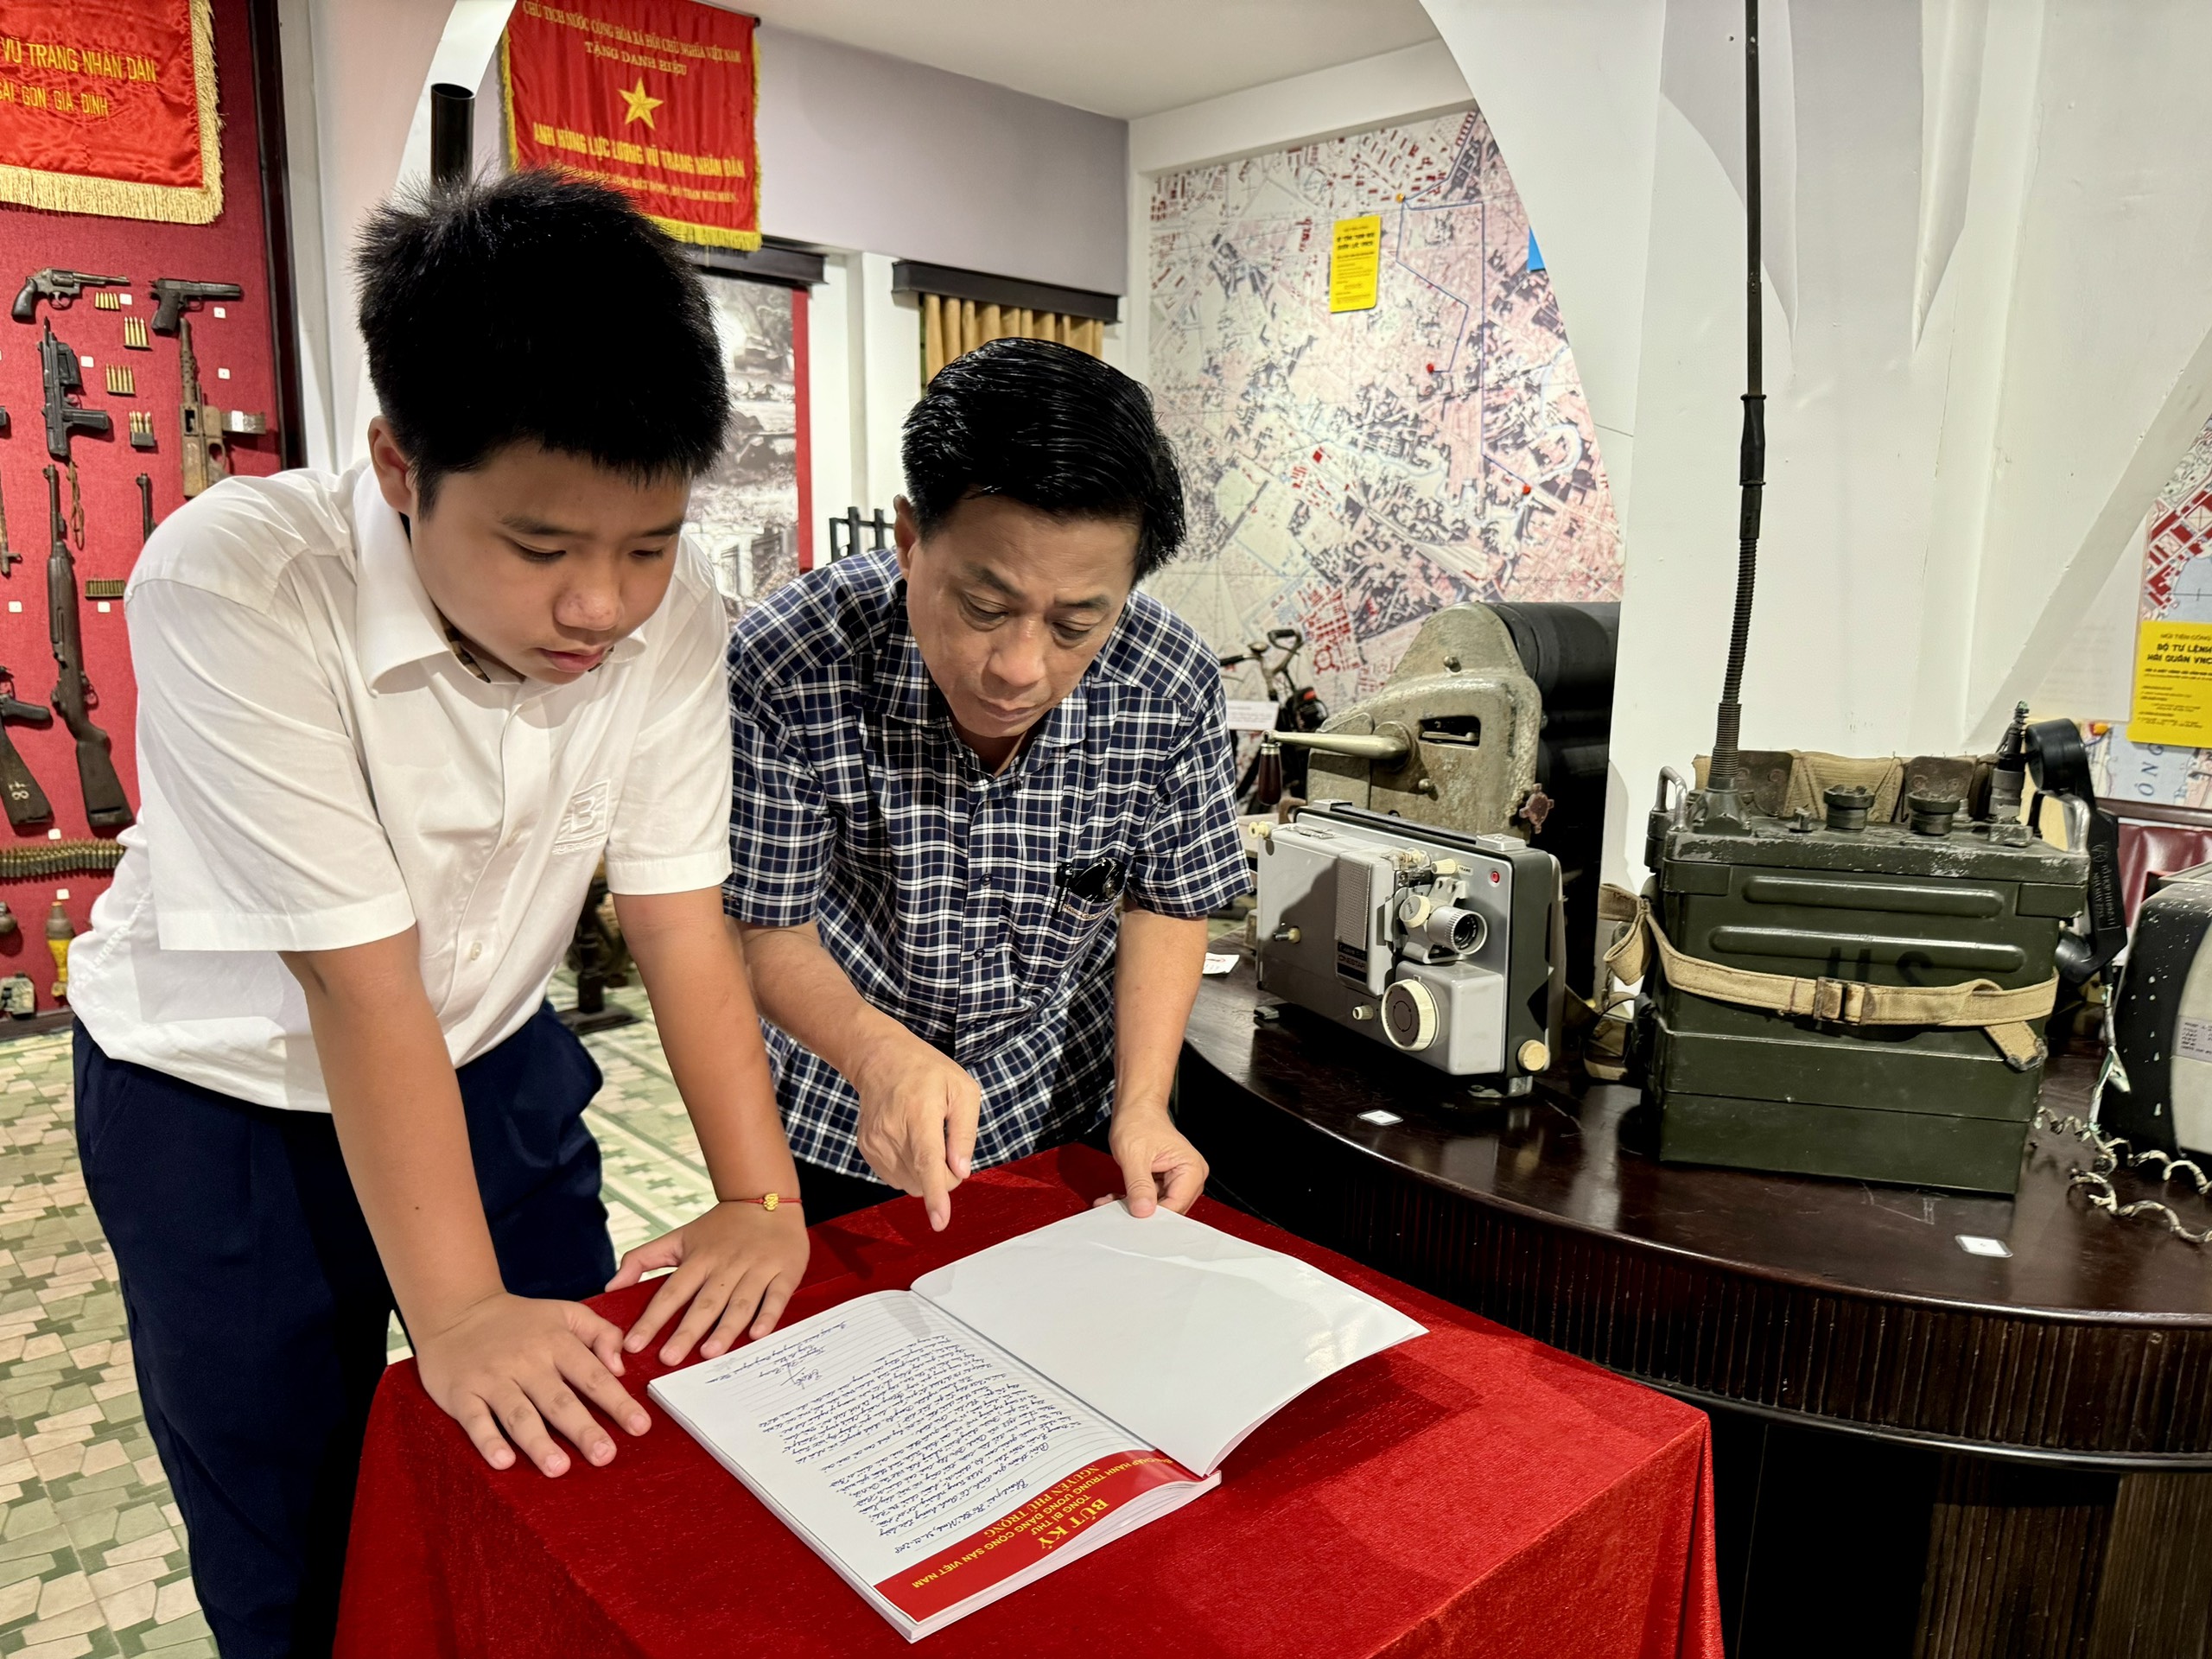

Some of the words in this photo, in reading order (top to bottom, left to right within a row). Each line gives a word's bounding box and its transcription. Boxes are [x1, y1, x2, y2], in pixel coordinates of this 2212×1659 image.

[26, 43, 79, 73] TRANG
[82, 50, 123, 79] NHÂN
[126, 54, 157, 83] DÂN
[53, 89, 74, 112] GIA
[1104, 1462, 1132, 1476] HÀNH
[1052, 1465, 1100, 1497] NGUYỄN
[1072, 1474, 1106, 1495] TRUNG
[1027, 1494, 1052, 1512] PHÚ
[1043, 1493, 1074, 1515] ƯƠNG
[1069, 1498, 1109, 1529] BÚT
[983, 1510, 1028, 1538] TRỌNG
[1014, 1512, 1045, 1533] ĐẢNG
[1051, 1511, 1065, 1522] BÍ
[1031, 1520, 1053, 1535] THƯ
[1037, 1526, 1069, 1549] KÝ
[983, 1531, 1015, 1550] CỘNG
[961, 1548, 985, 1562] SẢN
[938, 1560, 963, 1575] VIỆT
[912, 1573, 938, 1588] NAM
